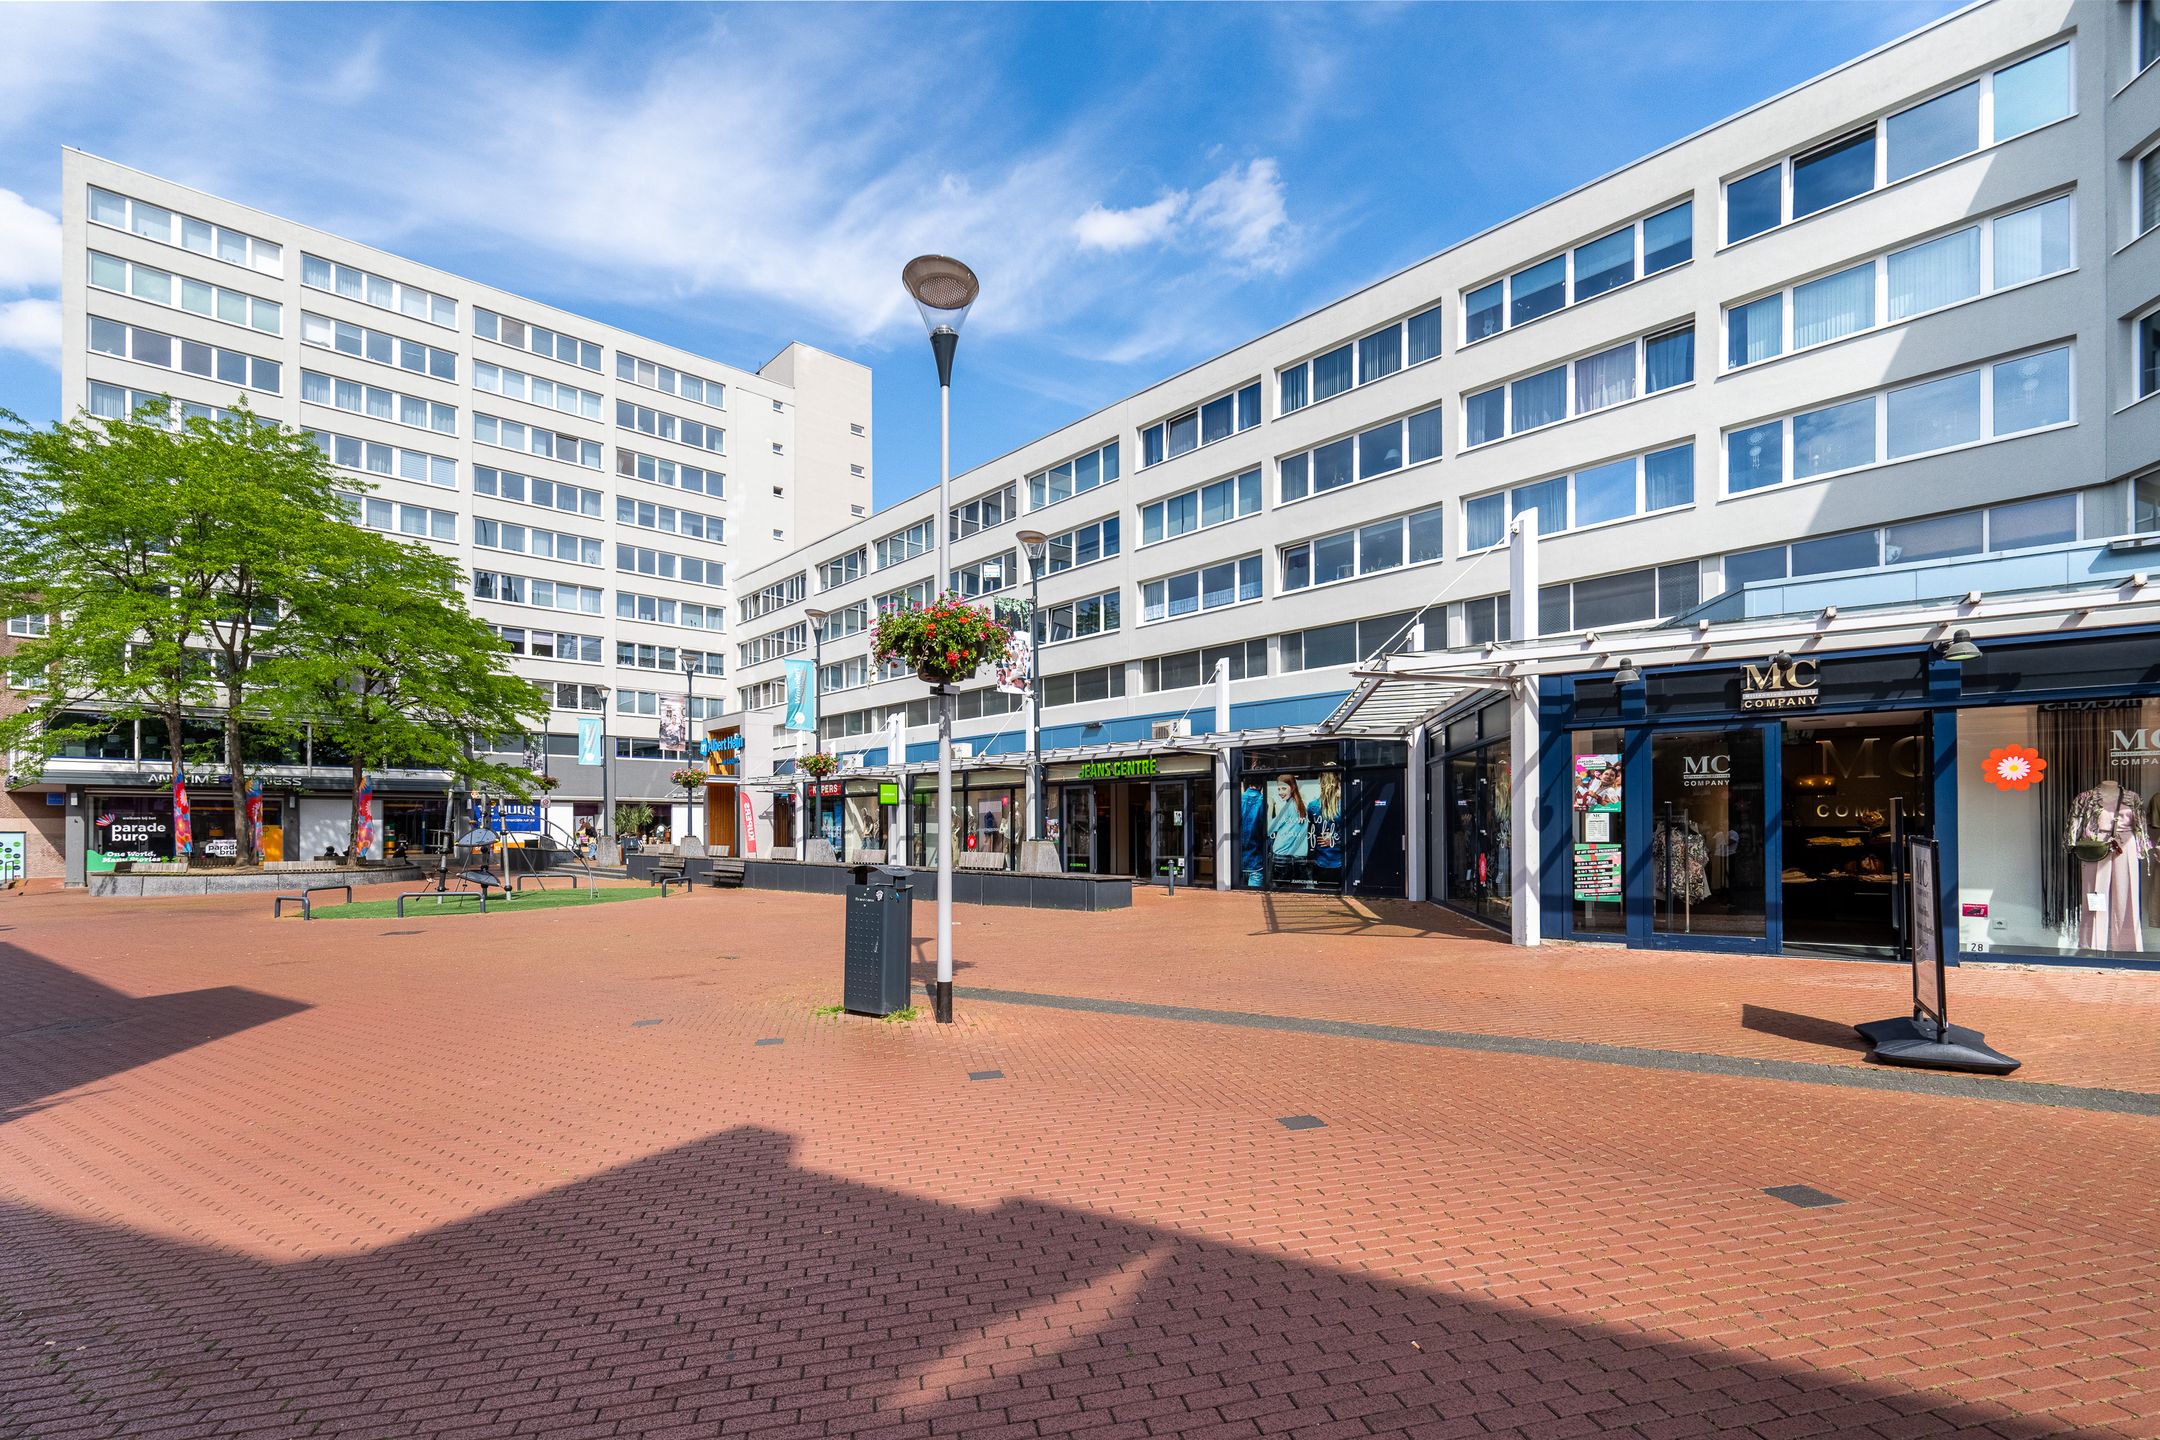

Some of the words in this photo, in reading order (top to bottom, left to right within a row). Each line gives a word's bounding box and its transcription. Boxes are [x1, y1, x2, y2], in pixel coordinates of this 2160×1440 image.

[1741, 659, 1818, 691] MC
[1744, 696, 1818, 709] COMPANY
[1079, 761, 1112, 778] JEANS
[1113, 759, 1157, 776] CENTRE
[1683, 755, 1731, 774] MC
[148, 773, 220, 784] ANTIME
[812, 784, 838, 794] KPERS
[112, 823, 166, 834] parade
[112, 832, 149, 841] buro
[1971, 943, 1984, 952] 28
